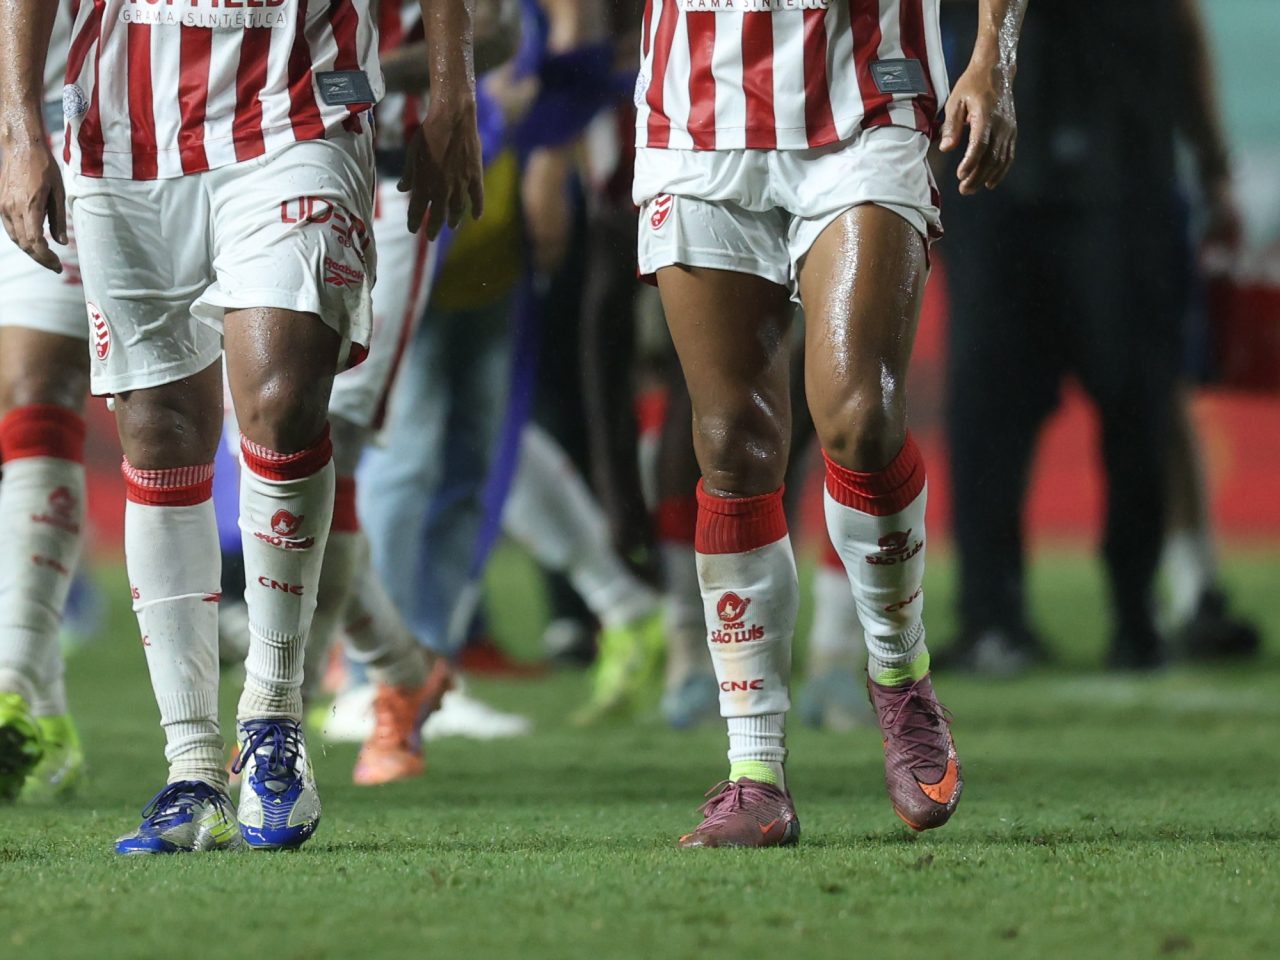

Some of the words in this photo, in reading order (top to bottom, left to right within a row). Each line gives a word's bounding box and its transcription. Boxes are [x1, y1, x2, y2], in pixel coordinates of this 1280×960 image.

[123, 9, 174, 22] GRAMA
[187, 10, 285, 26] SINTÉTICA
[258, 576, 304, 596] CNC
[721, 679, 765, 693] CNC
